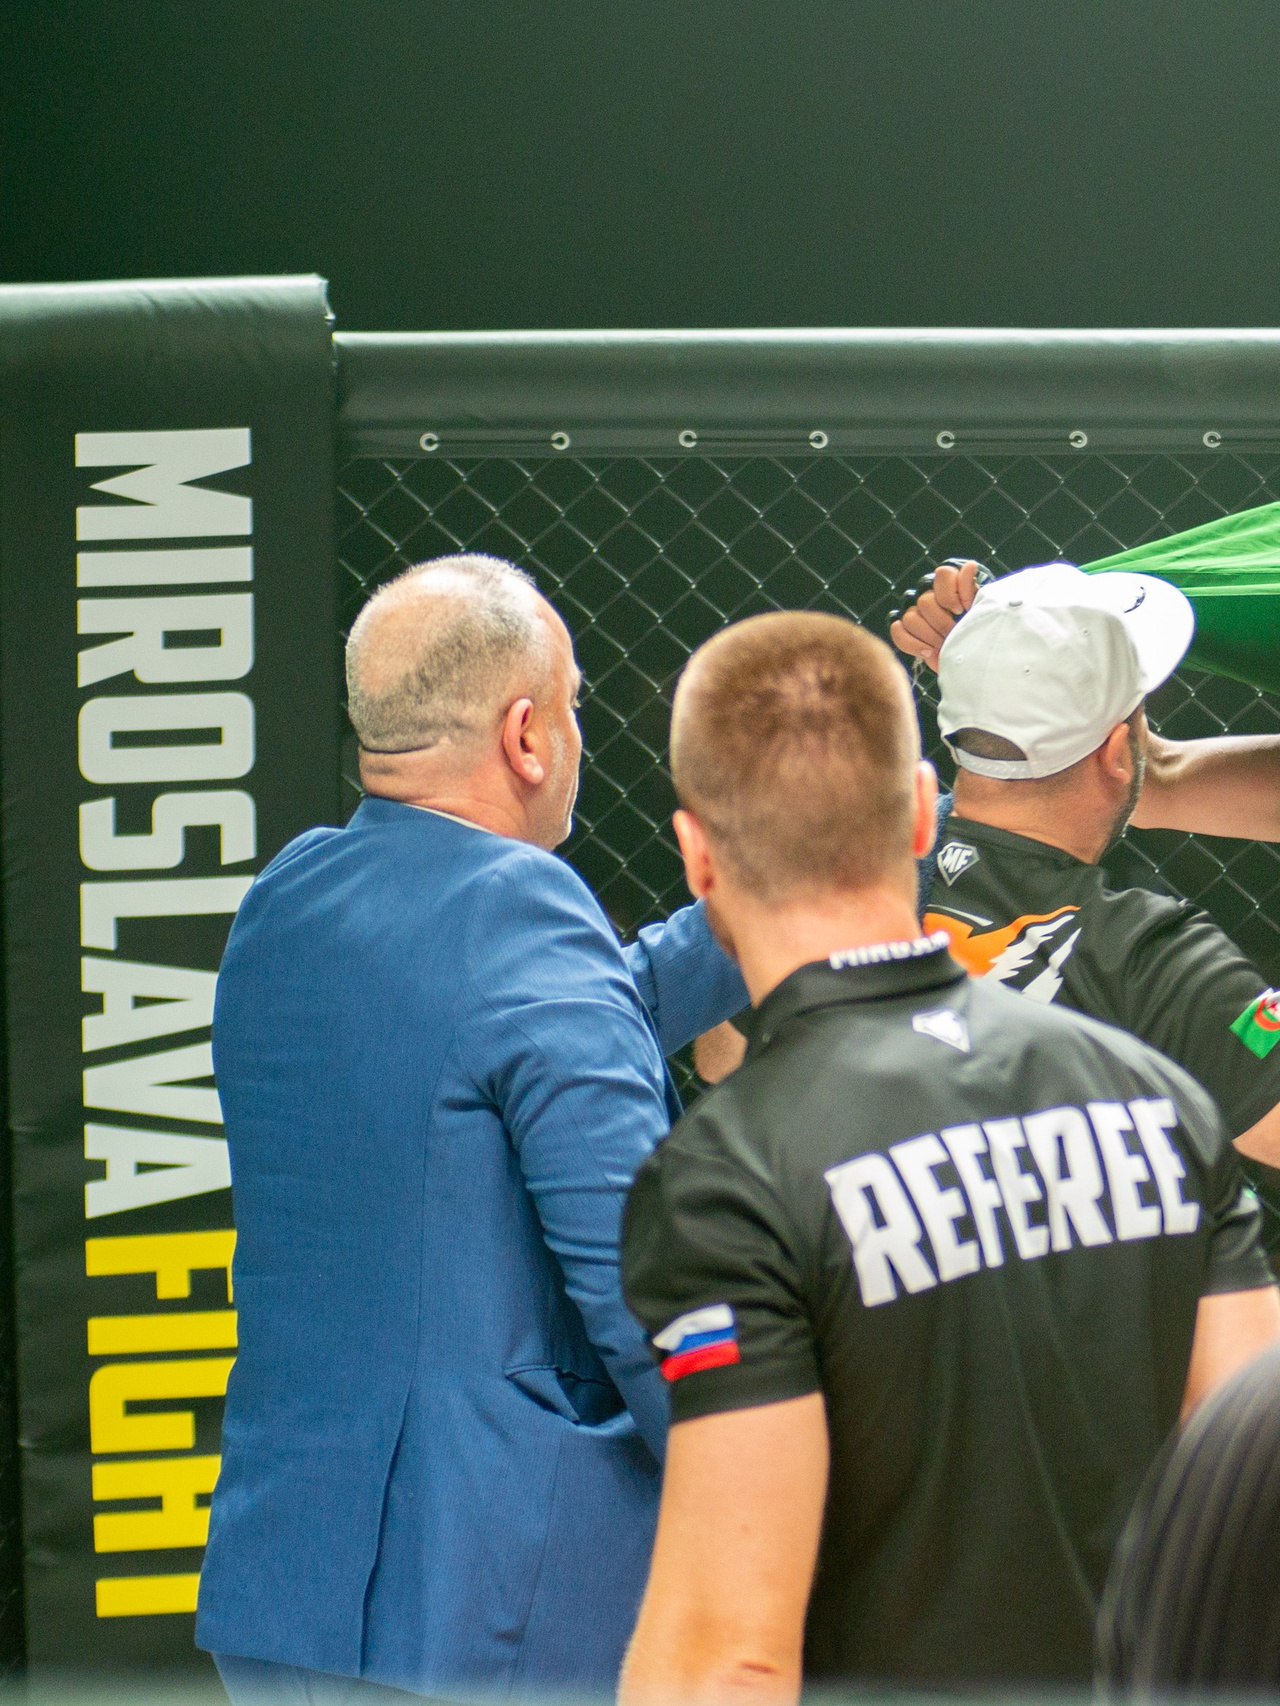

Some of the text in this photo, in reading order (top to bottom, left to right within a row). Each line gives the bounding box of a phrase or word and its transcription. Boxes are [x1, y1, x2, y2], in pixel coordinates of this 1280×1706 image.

[75, 427, 257, 1219] MIROSLAVA
[942, 847, 974, 874] MF
[823, 1098, 1200, 1308] REFEREE
